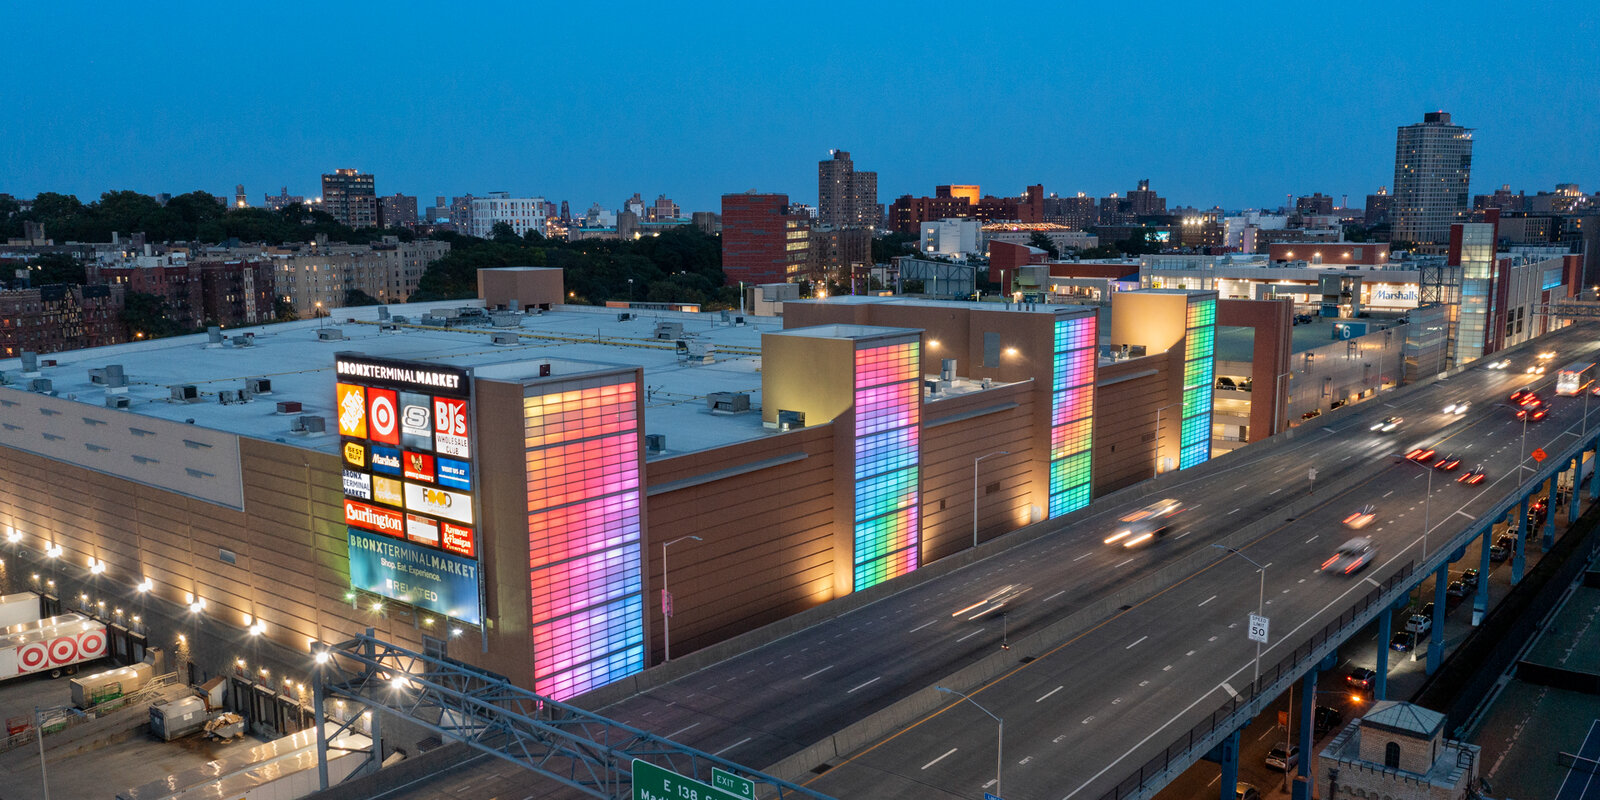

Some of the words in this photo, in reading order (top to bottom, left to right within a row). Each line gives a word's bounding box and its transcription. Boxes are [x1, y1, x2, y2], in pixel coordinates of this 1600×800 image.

[1374, 290, 1418, 300] Marshalls
[1343, 325, 1351, 339] 6
[435, 401, 466, 435] BJ's
[437, 436, 467, 447] WHOLESALE
[348, 446, 362, 455] BEST
[446, 445, 459, 455] CLUB
[349, 453, 361, 462] BUY
[372, 453, 400, 467] Marshalls
[343, 469, 362, 480] BRONX
[343, 478, 369, 490] TERMINAL
[344, 487, 366, 499] MARKET
[346, 503, 402, 531] Burlington
[381, 557, 396, 570] Shop.
[397, 562, 408, 572] Eat.
[409, 566, 441, 582] Experience.
[393, 580, 438, 602] RELATED
[1252, 627, 1265, 637] 50
[664, 779, 671, 792] E
[678, 784, 698, 800] 138
[716, 775, 735, 788] EXIT
[742, 783, 750, 795] 3
